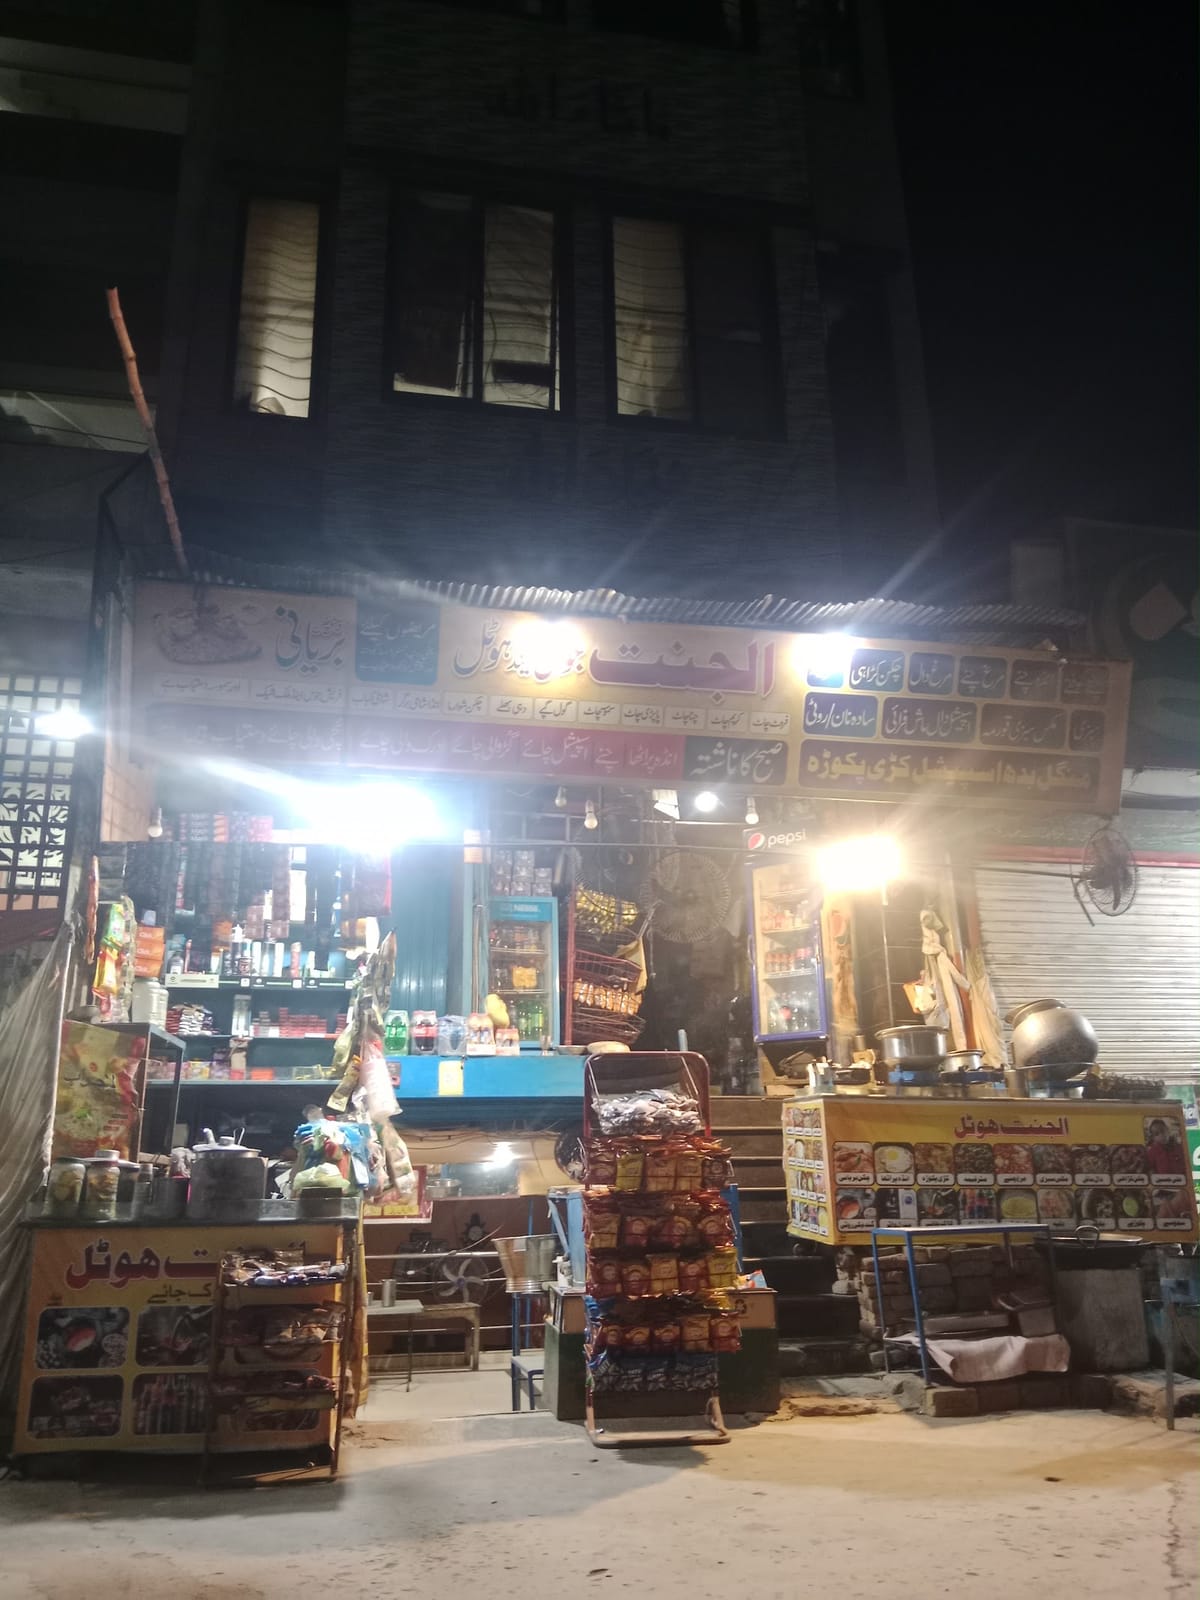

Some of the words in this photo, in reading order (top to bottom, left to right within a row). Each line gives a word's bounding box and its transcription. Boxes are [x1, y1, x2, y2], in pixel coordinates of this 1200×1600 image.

[274, 605, 345, 675] بریانی
[453, 617, 511, 676] ہوٹل
[589, 640, 776, 703] الجنت
[876, 656, 905, 686] چکن
[553, 701, 573, 717] گول
[689, 741, 738, 776] ناشتہ
[739, 747, 755, 776] کا
[752, 742, 783, 783] صبح
[807, 748, 867, 785] پکوڑہ
[867, 751, 912, 783] کڑی
[766, 830, 807, 848] pepsi
[954, 1113, 1002, 1140] ہوٹل
[1001, 1117, 1069, 1140] الجنت
[65, 1238, 160, 1290] ہوٹل
